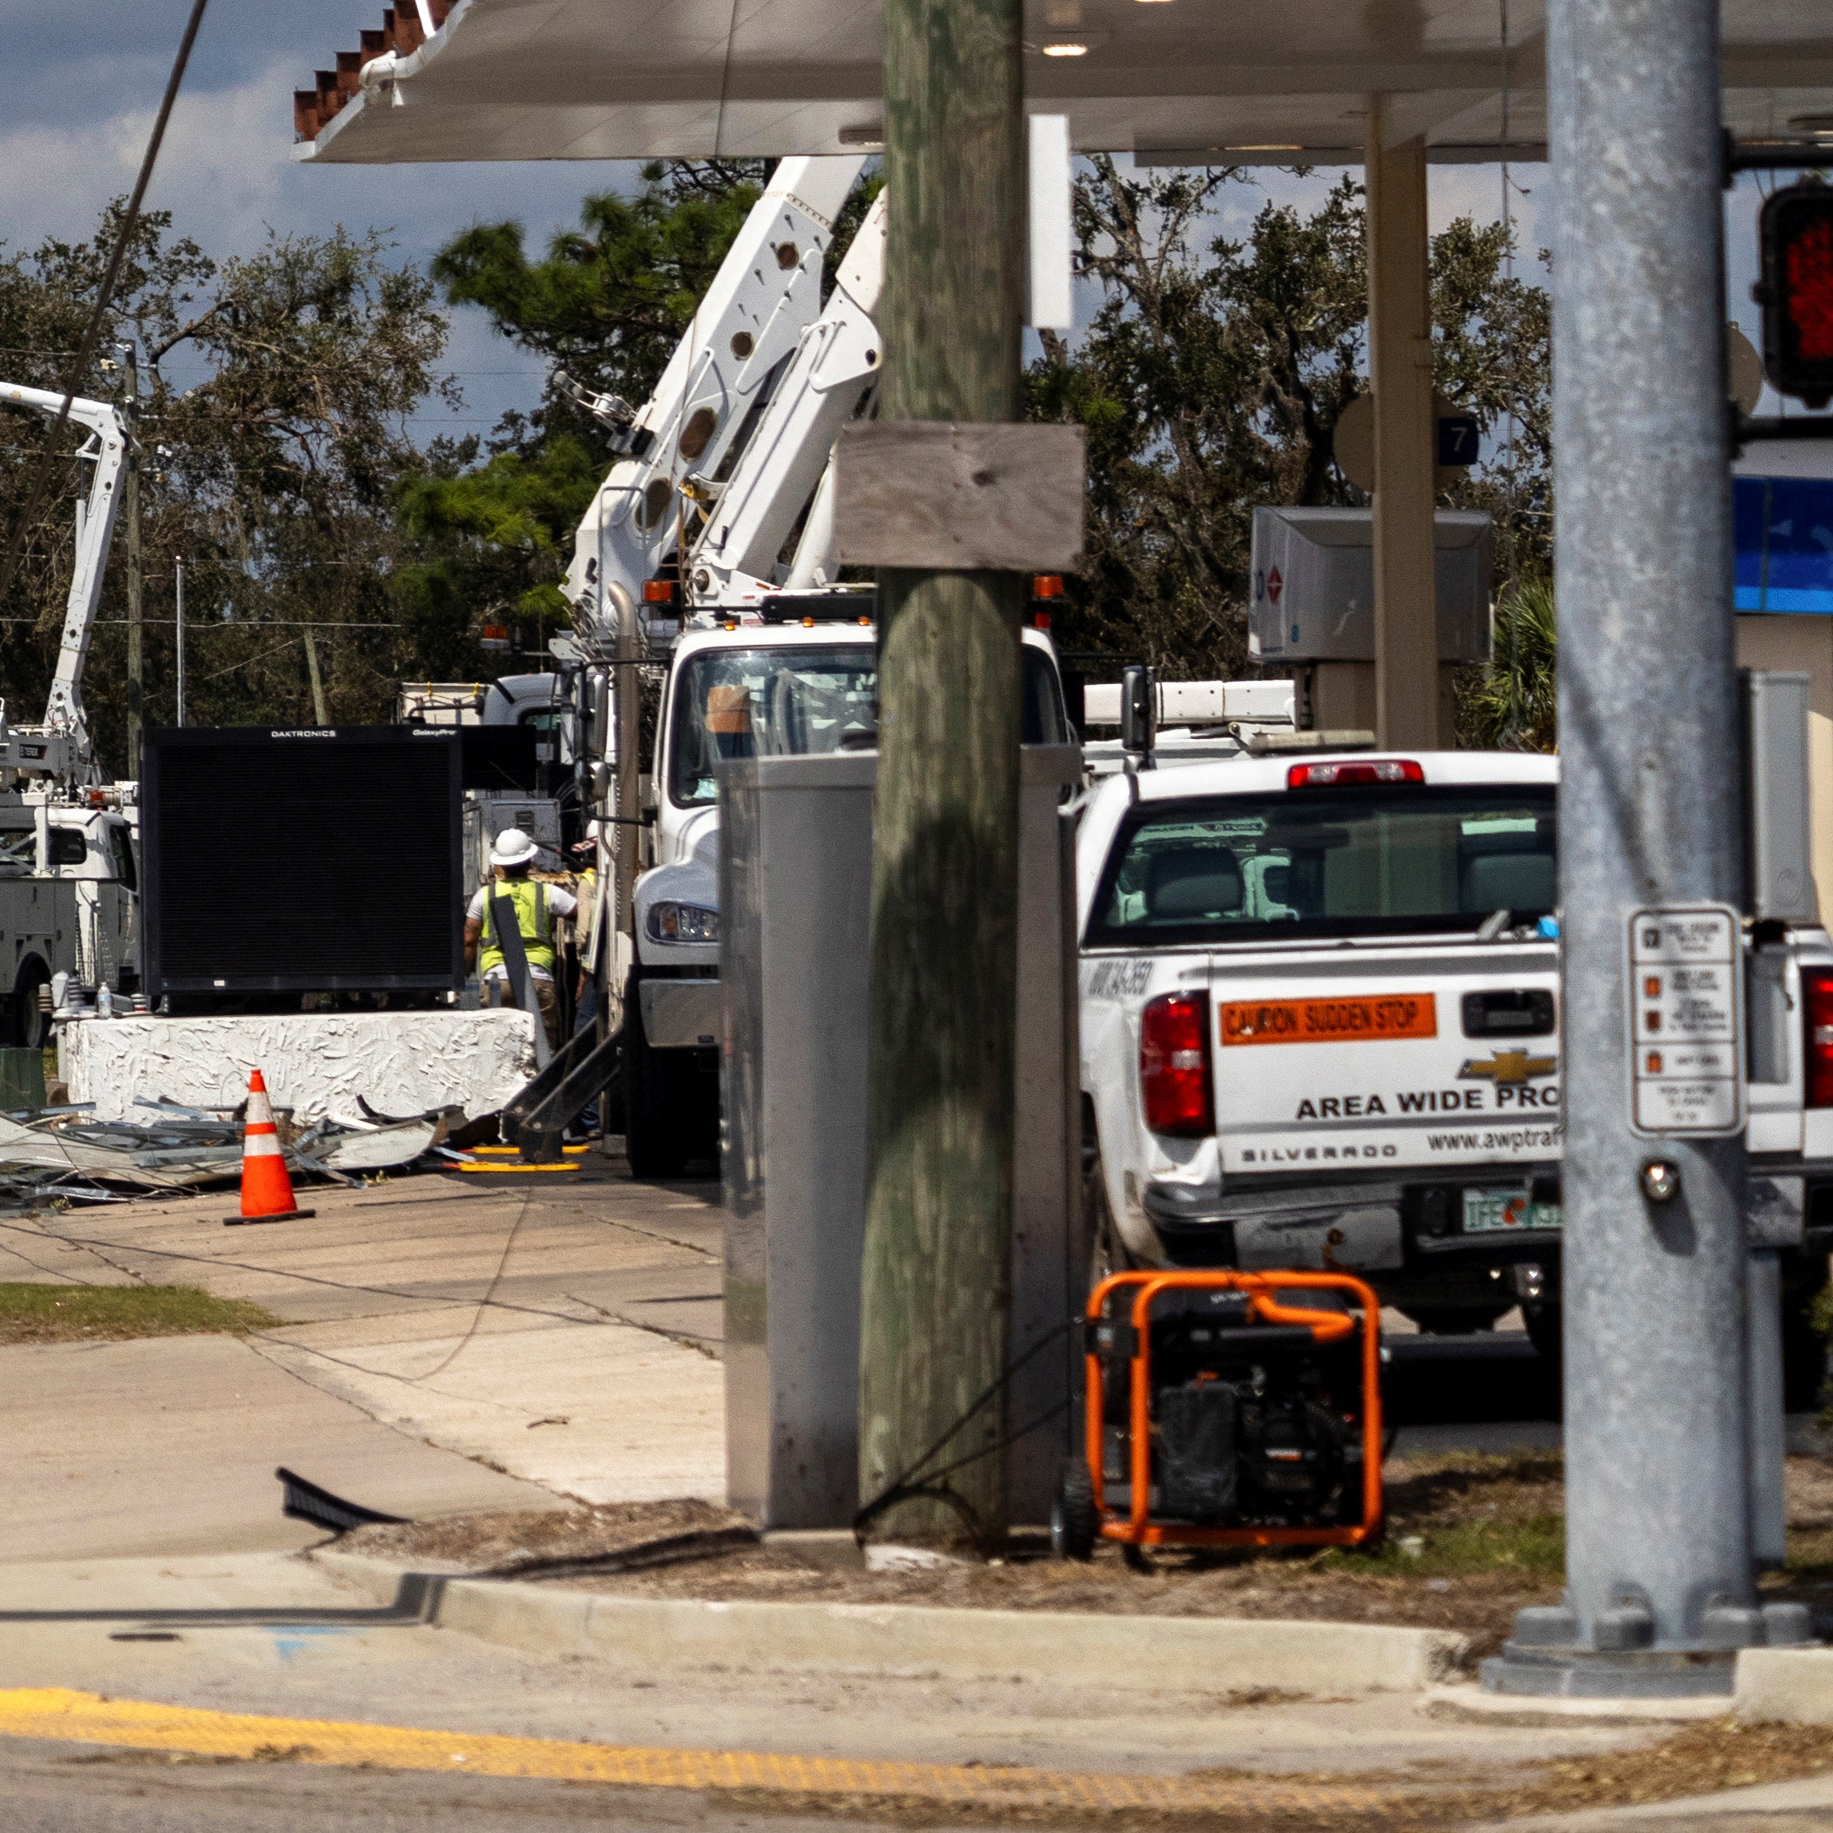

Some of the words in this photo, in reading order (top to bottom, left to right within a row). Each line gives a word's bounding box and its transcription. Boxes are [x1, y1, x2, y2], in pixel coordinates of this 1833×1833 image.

[1451, 427, 1468, 452] 7
[271, 730, 336, 738] DAKTRONICS
[1305, 1003, 1371, 1032] SUDDEN
[1375, 1001, 1417, 1029] STOP
[1295, 1094, 1387, 1119] AREA
[1396, 1089, 1482, 1113] WIDE
[1241, 1144, 1397, 1162] SILVERADO
